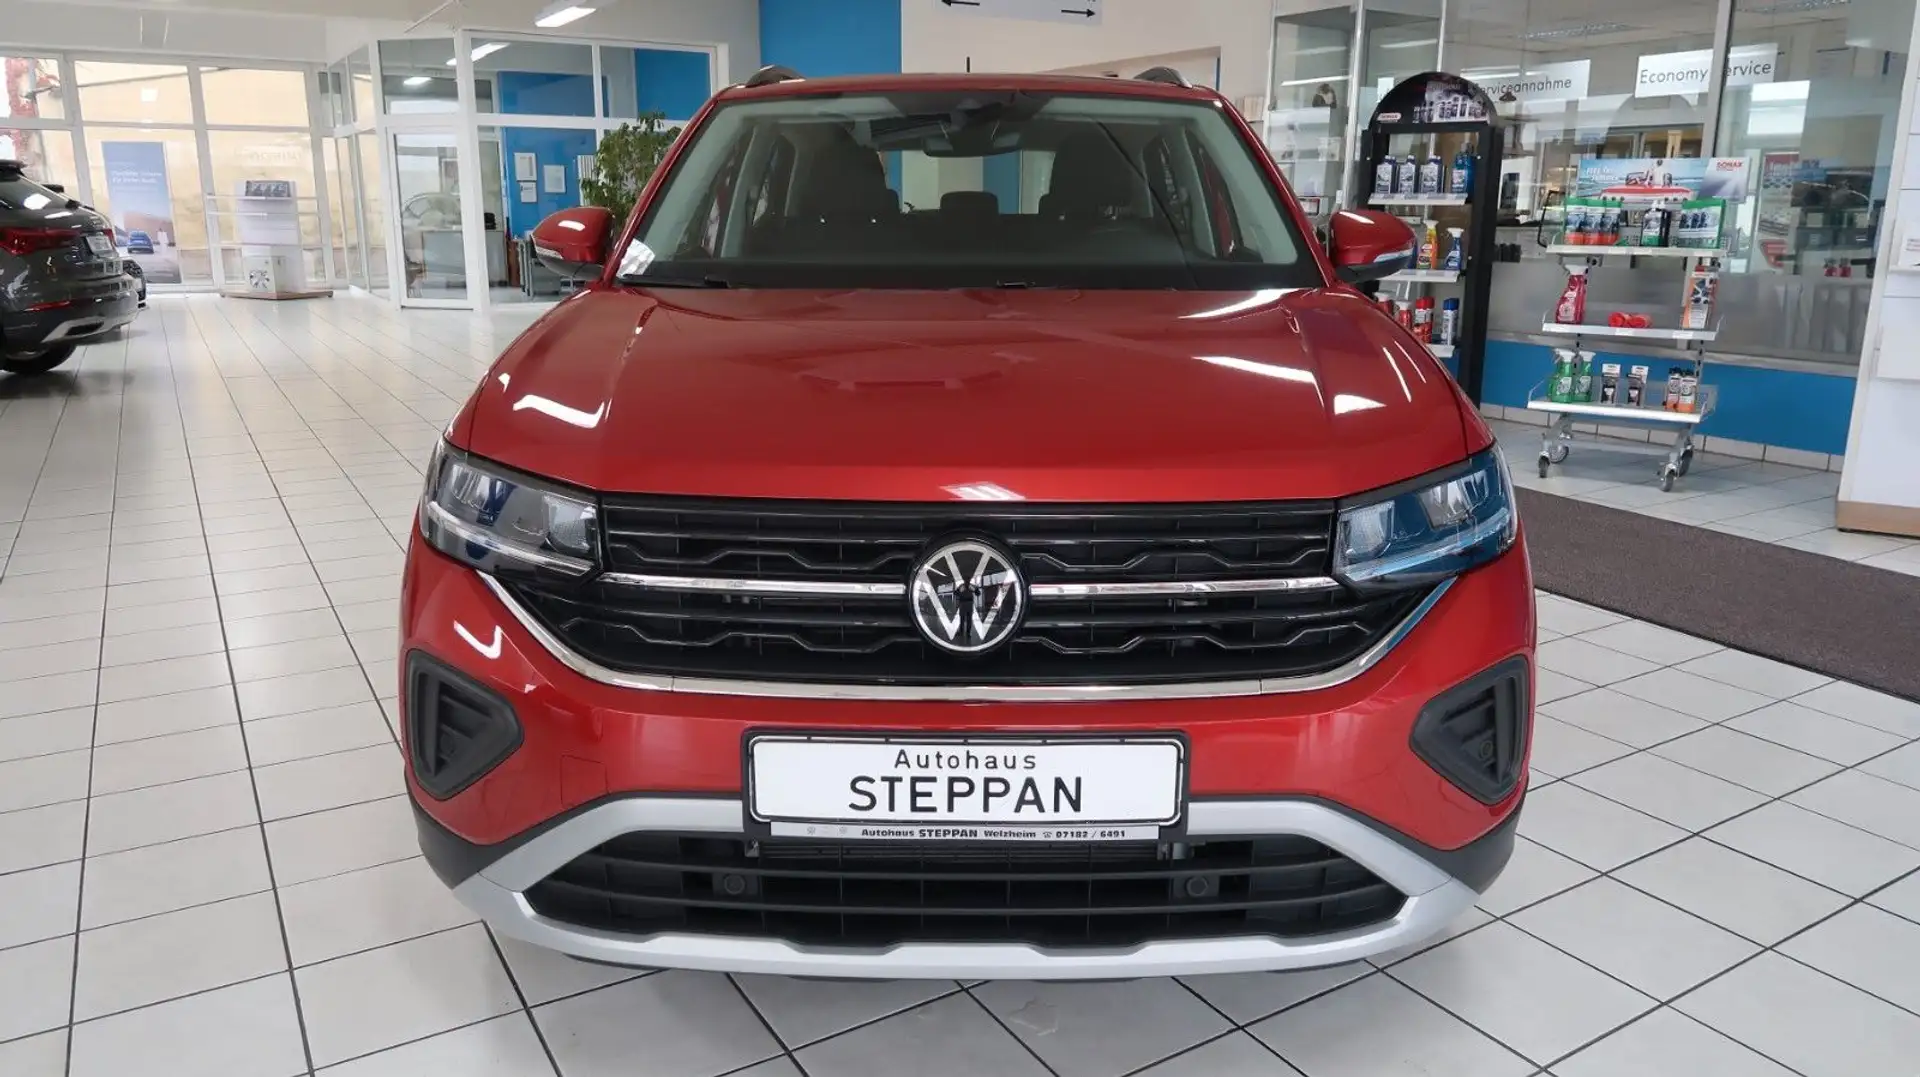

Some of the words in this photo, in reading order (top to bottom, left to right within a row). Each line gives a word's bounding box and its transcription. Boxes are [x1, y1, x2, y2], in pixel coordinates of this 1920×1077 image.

[1640, 68, 1709, 84] Economy
[1724, 60, 1772, 77] ervice
[1475, 76, 1572, 96] erviceannahme
[894, 748, 1036, 769] Autohaus
[848, 775, 1082, 813] STEPPAN
[861, 828, 915, 838] Autohaus
[919, 828, 978, 838] STEPPAN
[983, 829, 1036, 839] Welzheim
[1055, 831, 1088, 839] 07182
[1100, 830, 1126, 838] 6491
